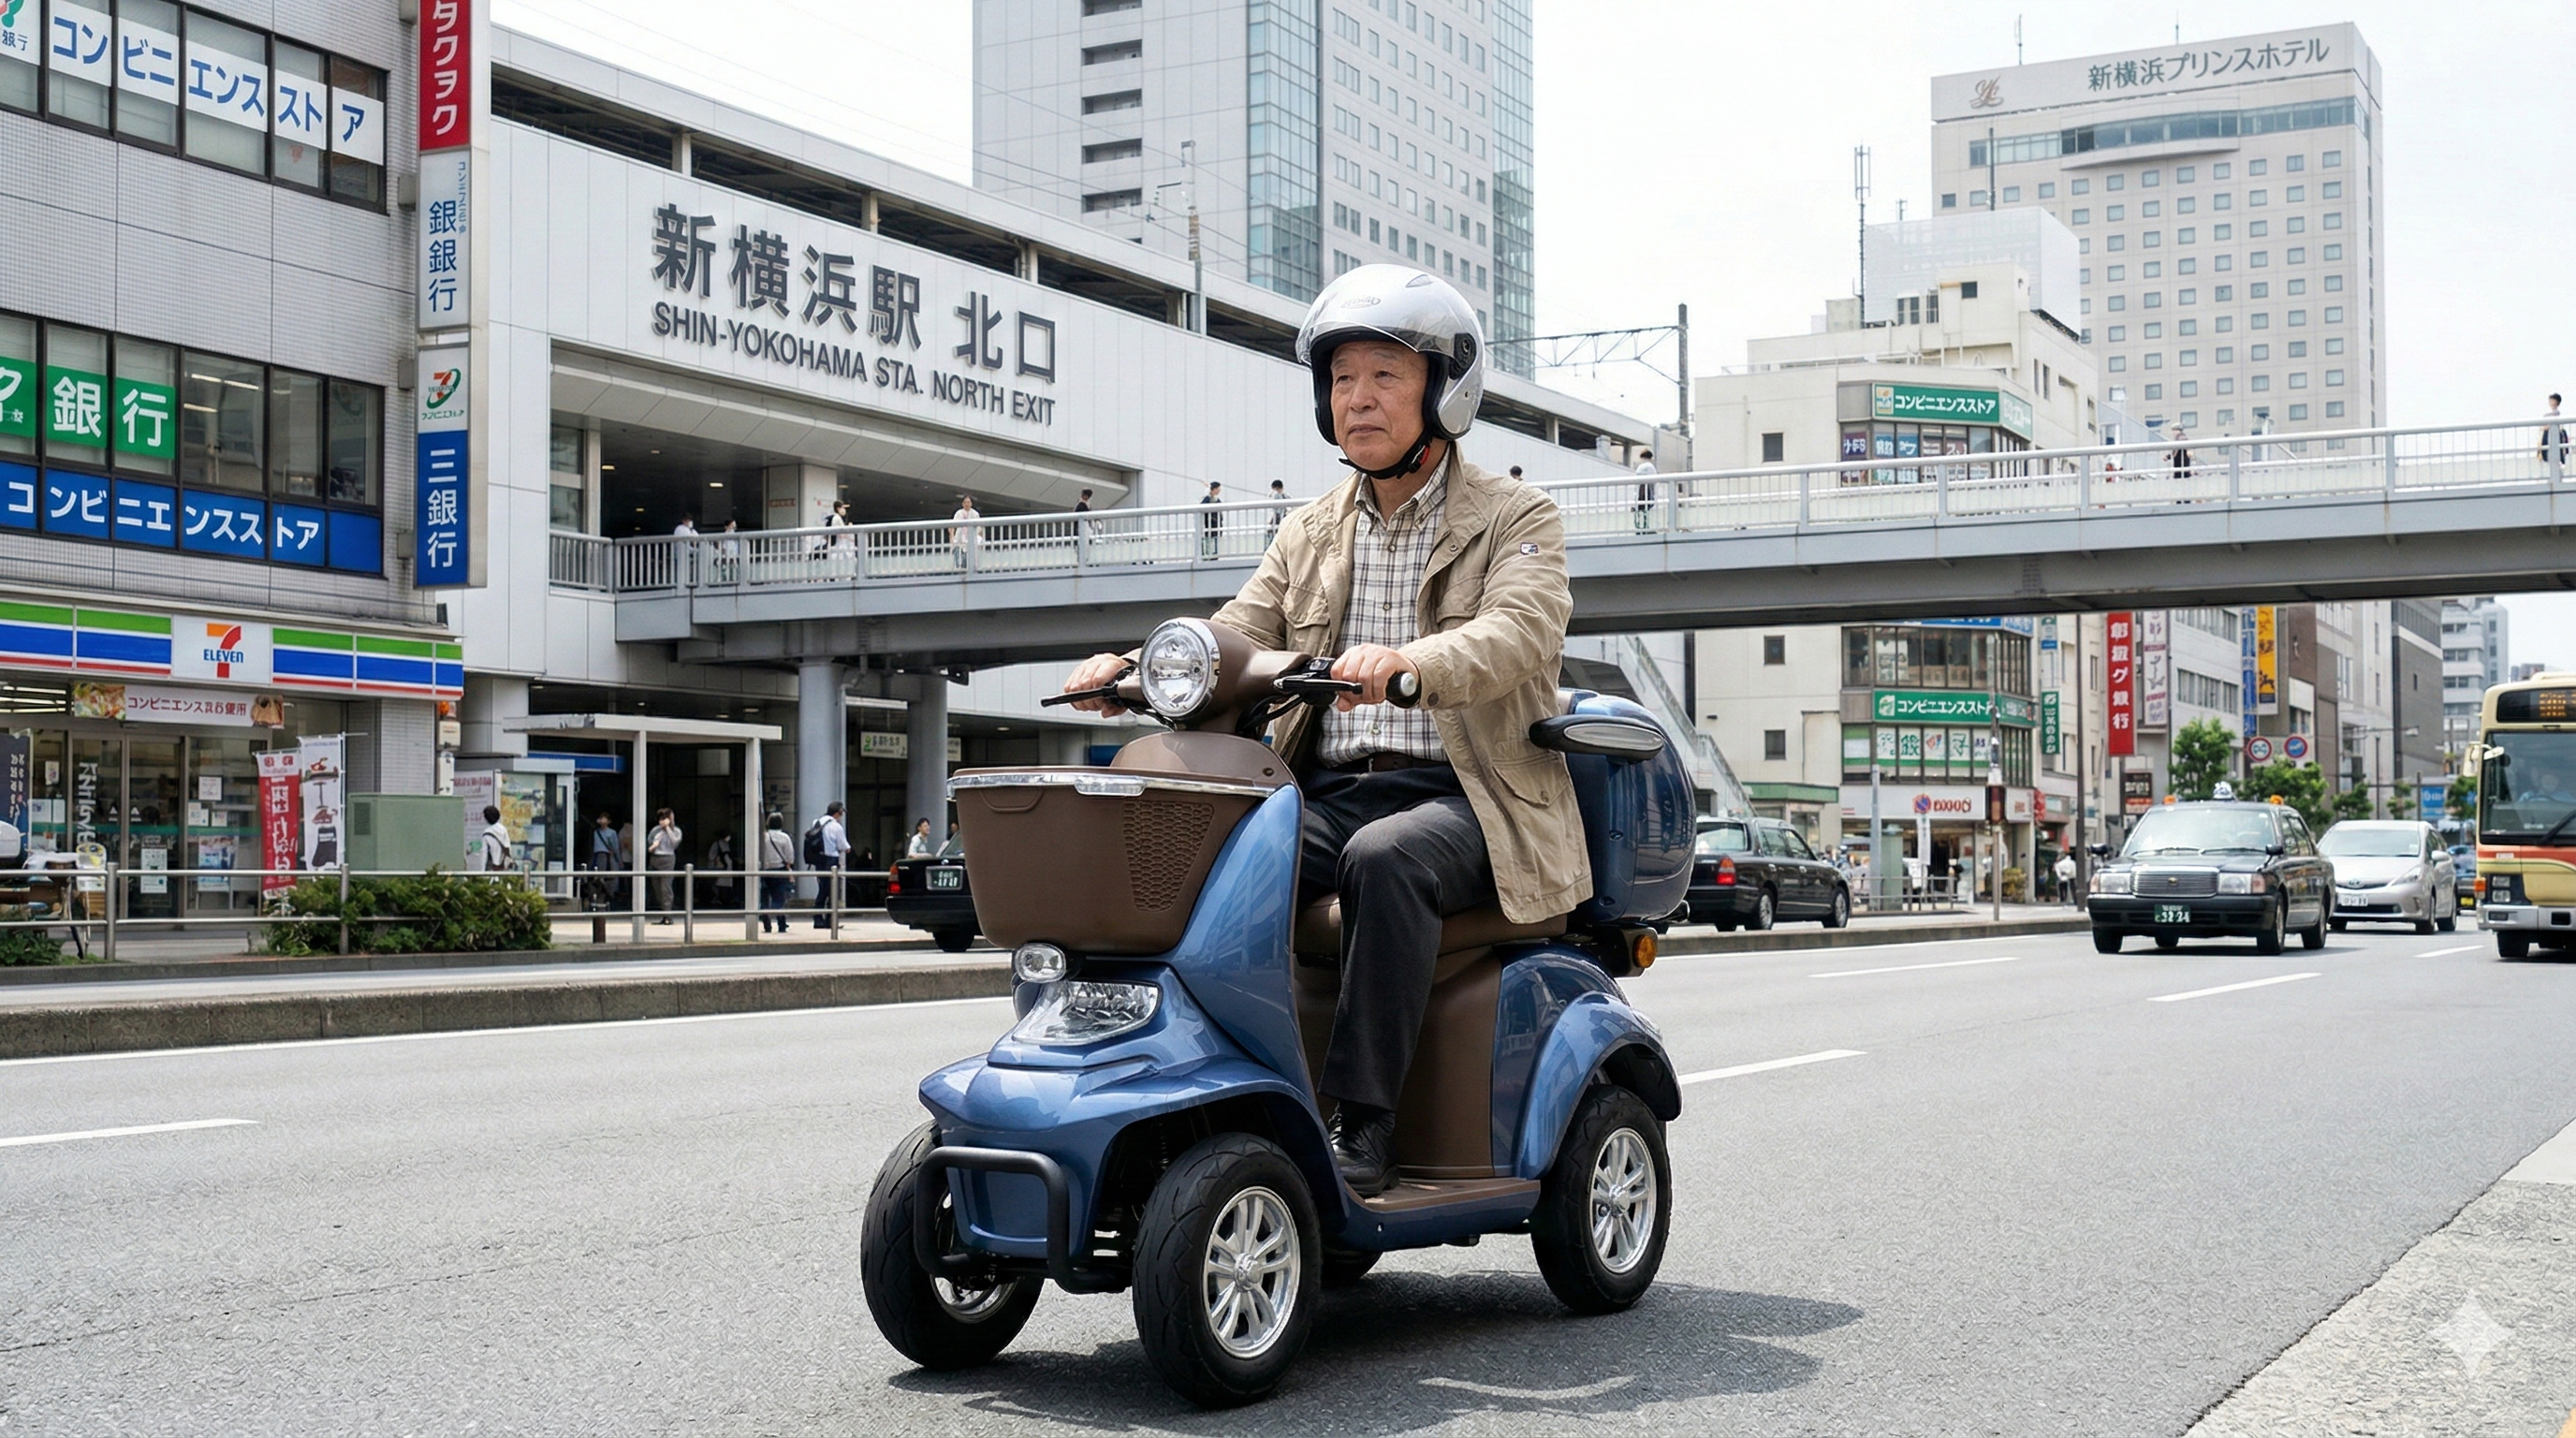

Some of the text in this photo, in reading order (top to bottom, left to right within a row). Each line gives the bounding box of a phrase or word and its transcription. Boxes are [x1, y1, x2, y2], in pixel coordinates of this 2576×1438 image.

[53, 16, 365, 142] コンビニエンスストア
[2087, 37, 2330, 92] 新横浜プリンスホテル
[428, 199, 457, 313] 銀銀行
[652, 203, 1056, 384] 新横浜駅 北口
[653, 301, 1056, 426] SHIN-YOKOHAMA STA. NORTH EXIT
[1895, 395, 1996, 414] コンビニエンスストア
[8, 481, 319, 550] コンビニエンスストア
[428, 448, 457, 568] 三銀行
